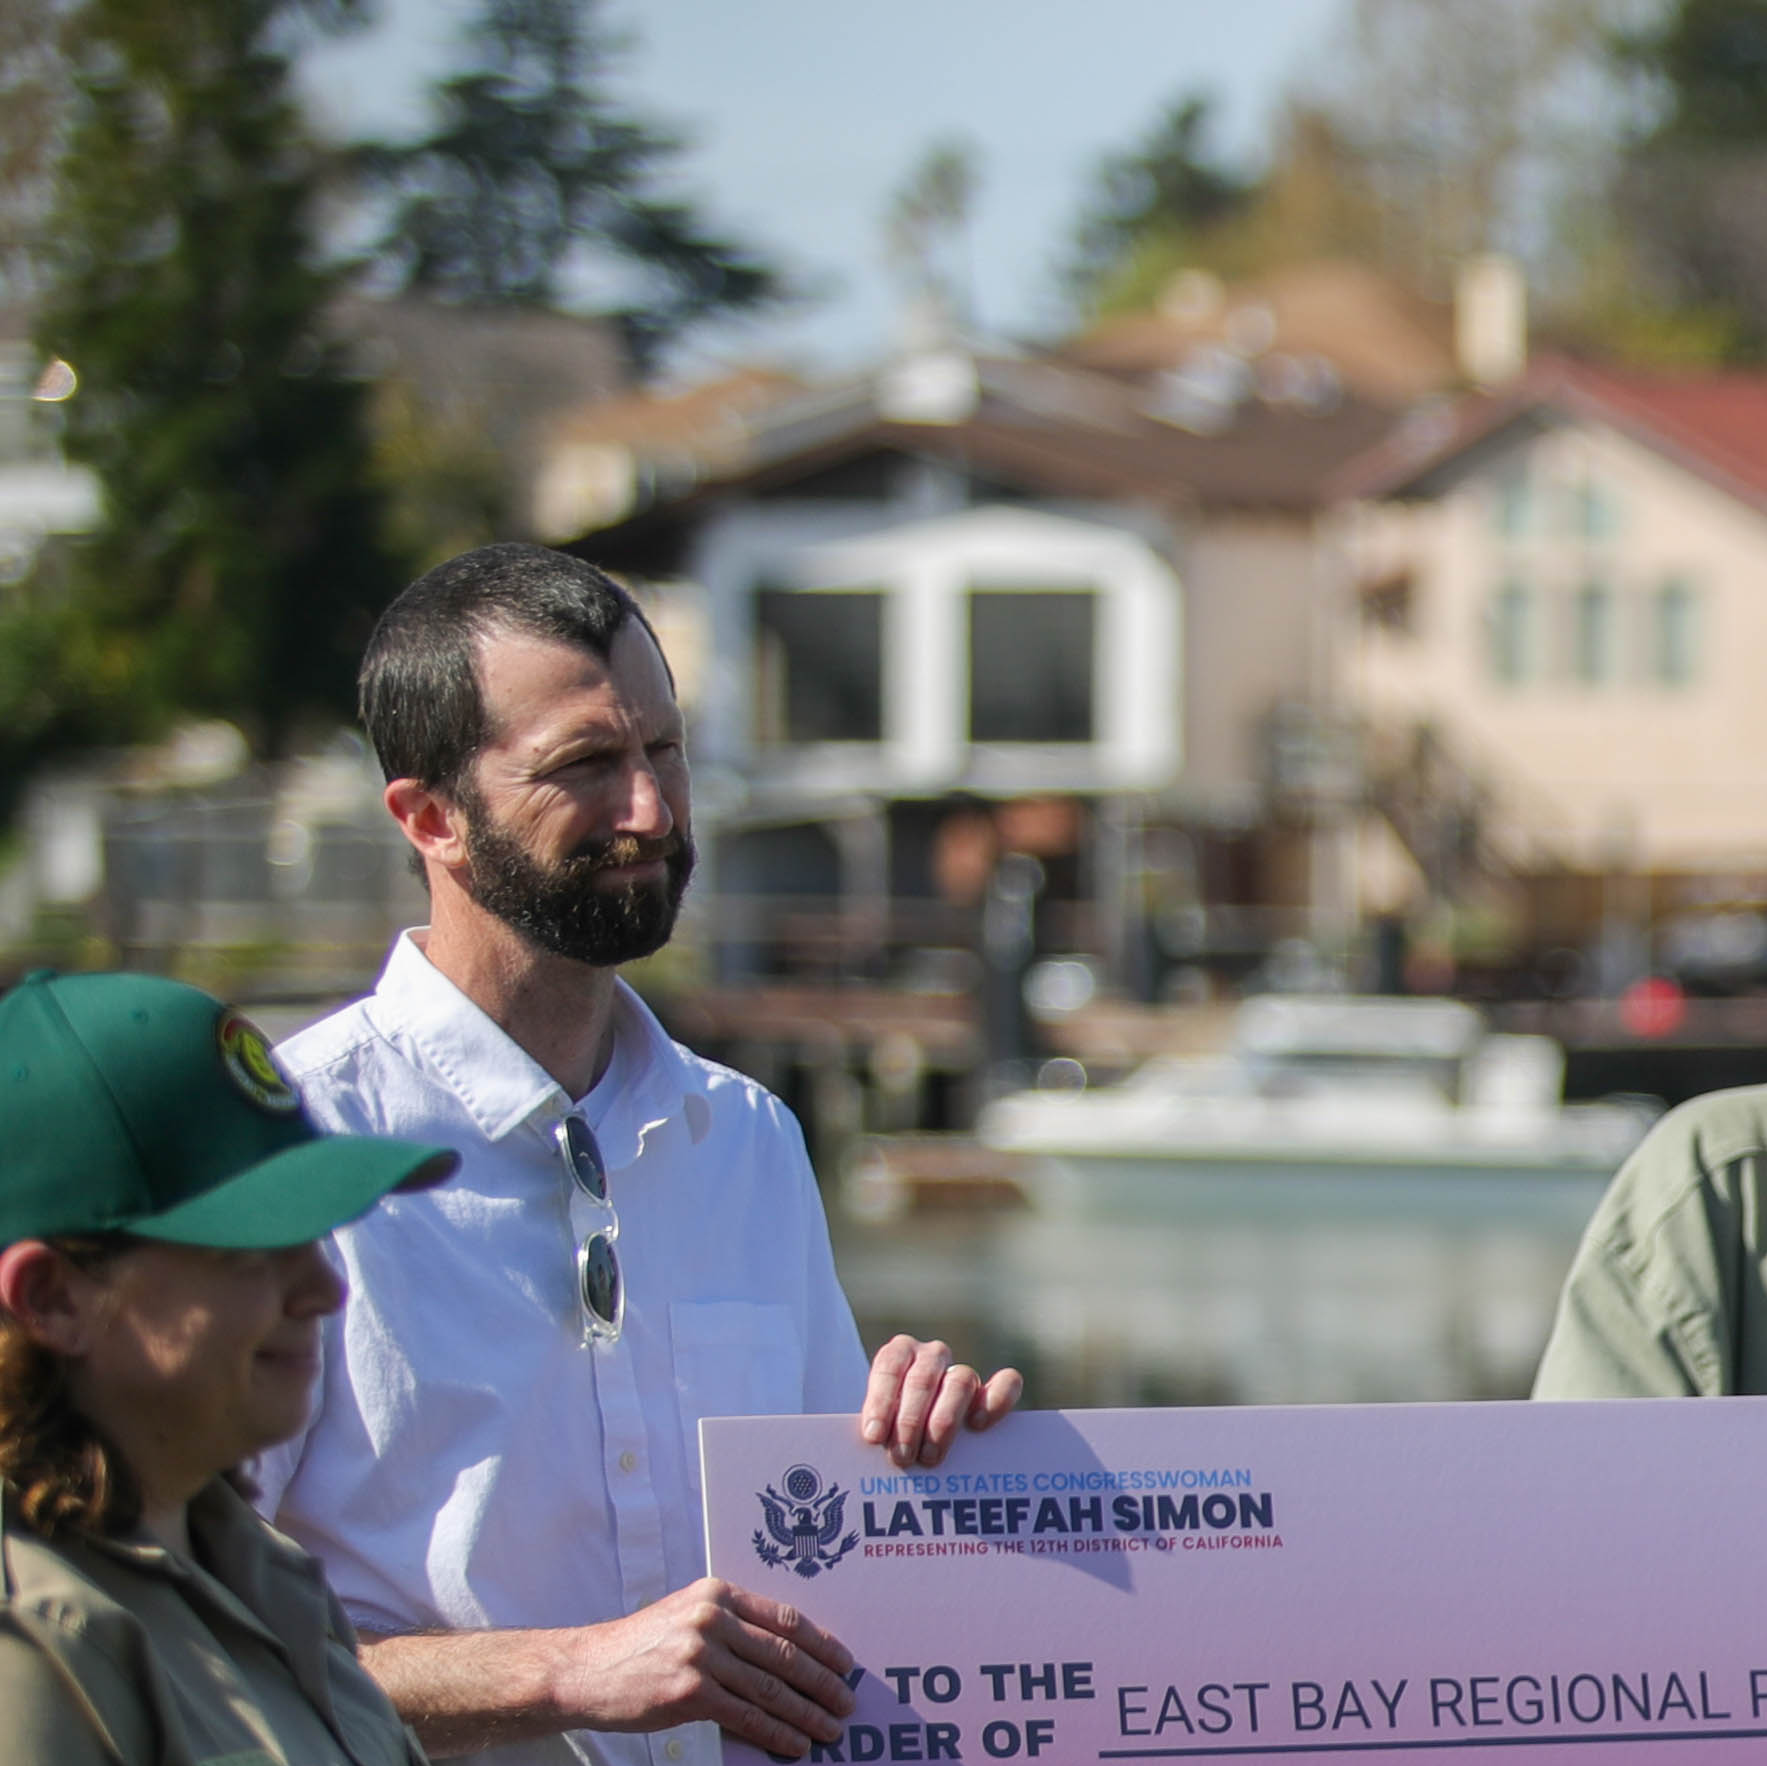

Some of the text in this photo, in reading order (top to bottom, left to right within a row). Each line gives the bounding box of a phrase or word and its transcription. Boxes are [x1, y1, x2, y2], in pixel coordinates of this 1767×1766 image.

[859, 1469, 1252, 1496] UNITED STATES CONGRESSWOMAN
[863, 1534, 1284, 1558] REPRESENTING THE 12TH DISTRICT OF CALIFORNIA
[885, 1665, 962, 1704] TO
[980, 1662, 1096, 1701] THE
[1117, 1681, 1271, 1736] EAST
[1291, 1677, 1408, 1731] BAY
[1429, 1670, 1732, 1728] REGIONAL
[982, 1719, 1056, 1759] OF
